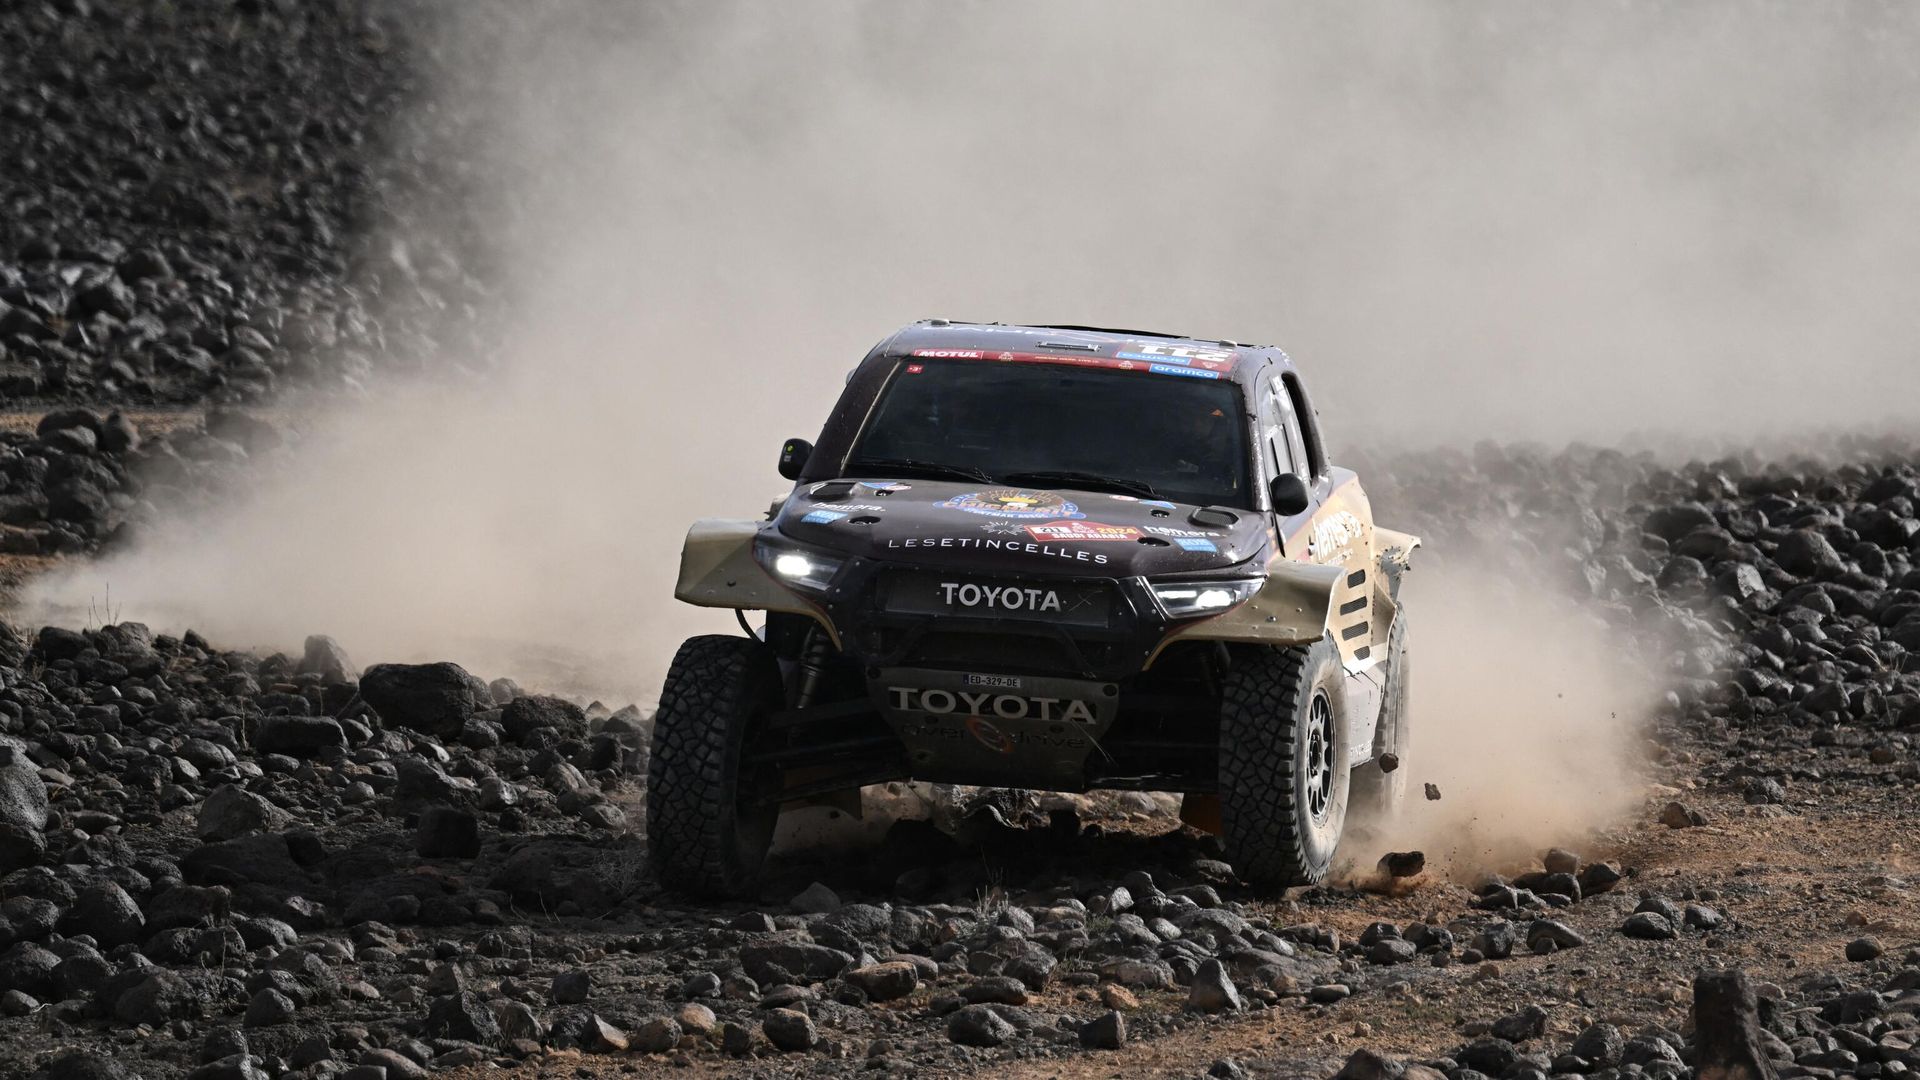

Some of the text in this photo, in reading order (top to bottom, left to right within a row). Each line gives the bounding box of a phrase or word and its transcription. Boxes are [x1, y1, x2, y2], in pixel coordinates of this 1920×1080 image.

[1154, 365, 1214, 378] aramco
[1097, 527, 1138, 535] 2024
[888, 538, 1108, 564] LESETINCELLES
[941, 583, 1062, 612] TOYOTA
[888, 686, 1097, 725] TOYOTA
